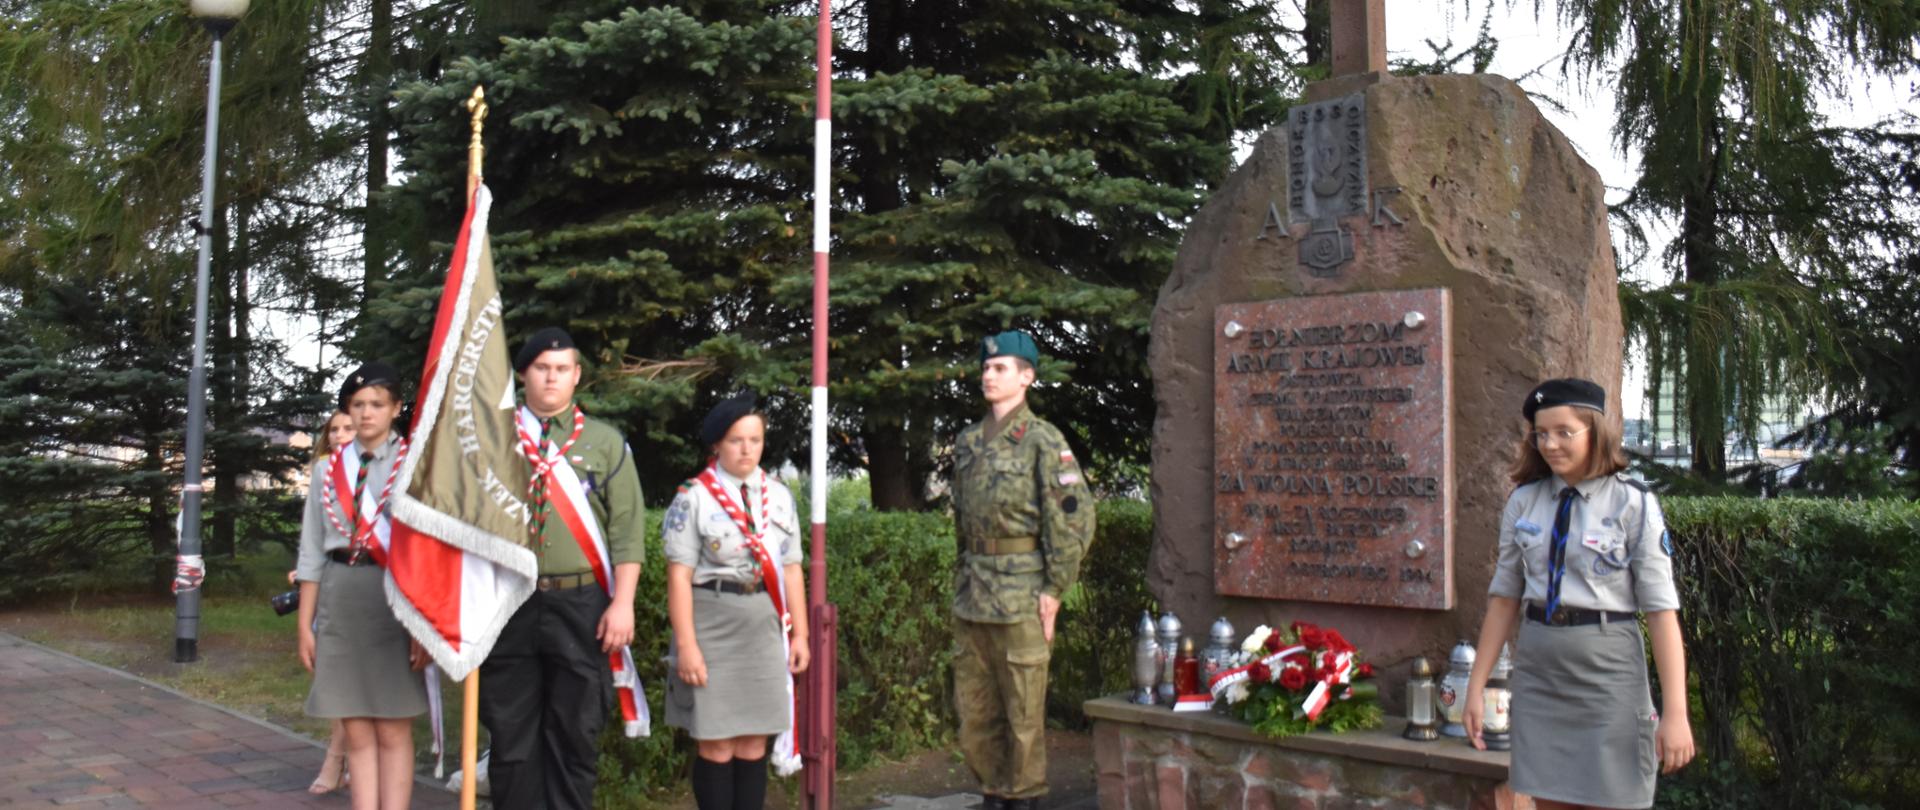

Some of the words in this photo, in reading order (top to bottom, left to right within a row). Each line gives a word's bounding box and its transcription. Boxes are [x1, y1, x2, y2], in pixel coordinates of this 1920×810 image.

[1257, 202, 1289, 240] A
[1372, 186, 1405, 227] K
[1219, 474, 1246, 494] ZA
